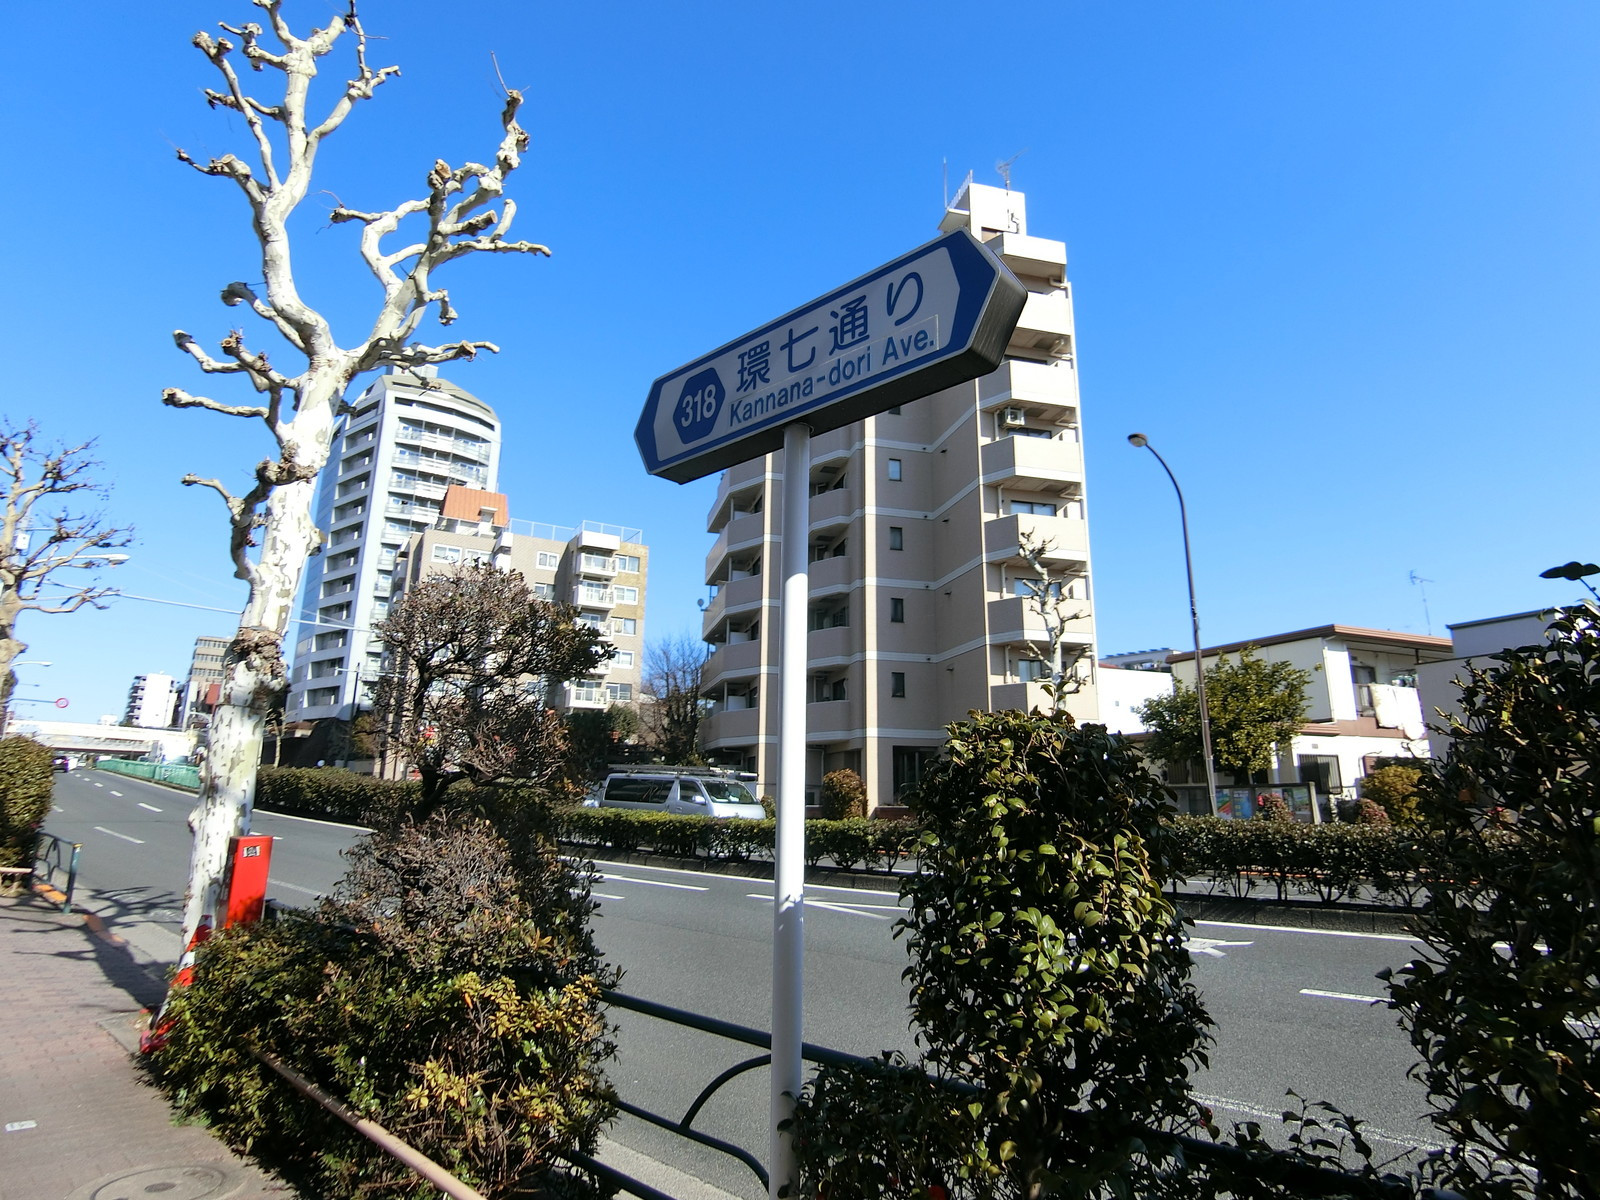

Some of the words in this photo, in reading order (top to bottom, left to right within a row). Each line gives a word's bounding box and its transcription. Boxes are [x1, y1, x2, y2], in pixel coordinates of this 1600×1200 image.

[729, 346, 872, 427] Kannana-dori
[882, 328, 935, 366] Ave.
[736, 271, 924, 393] 環七通り
[680, 383, 717, 428] 318
